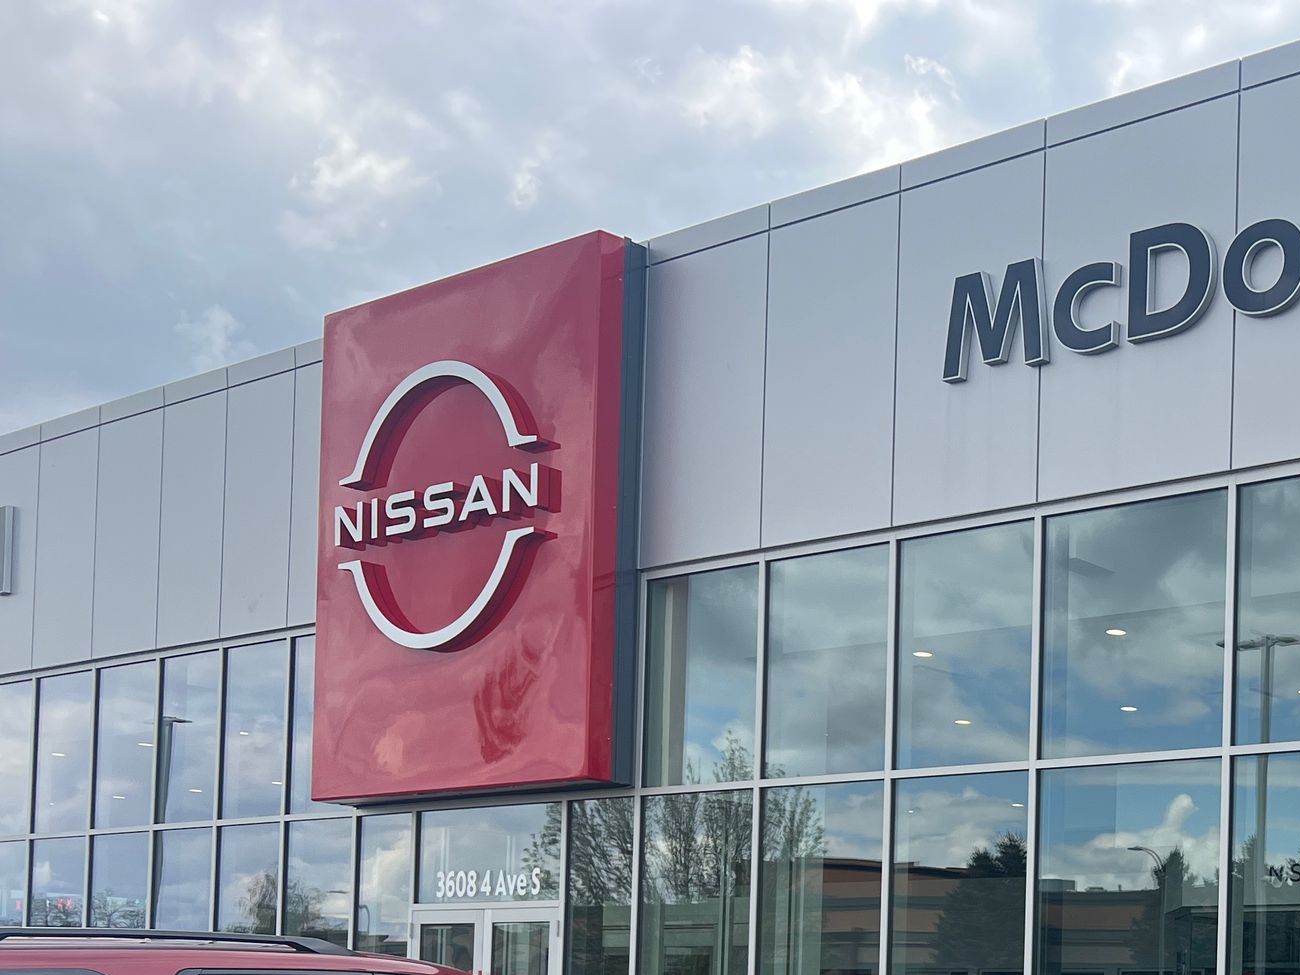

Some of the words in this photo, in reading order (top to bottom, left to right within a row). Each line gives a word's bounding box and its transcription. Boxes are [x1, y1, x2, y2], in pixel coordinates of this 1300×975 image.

[334, 462, 539, 547] NISSAN
[435, 870, 477, 898] 3608
[480, 869, 492, 896] 4
[494, 868, 527, 896] Ave
[531, 867, 541, 896] S
